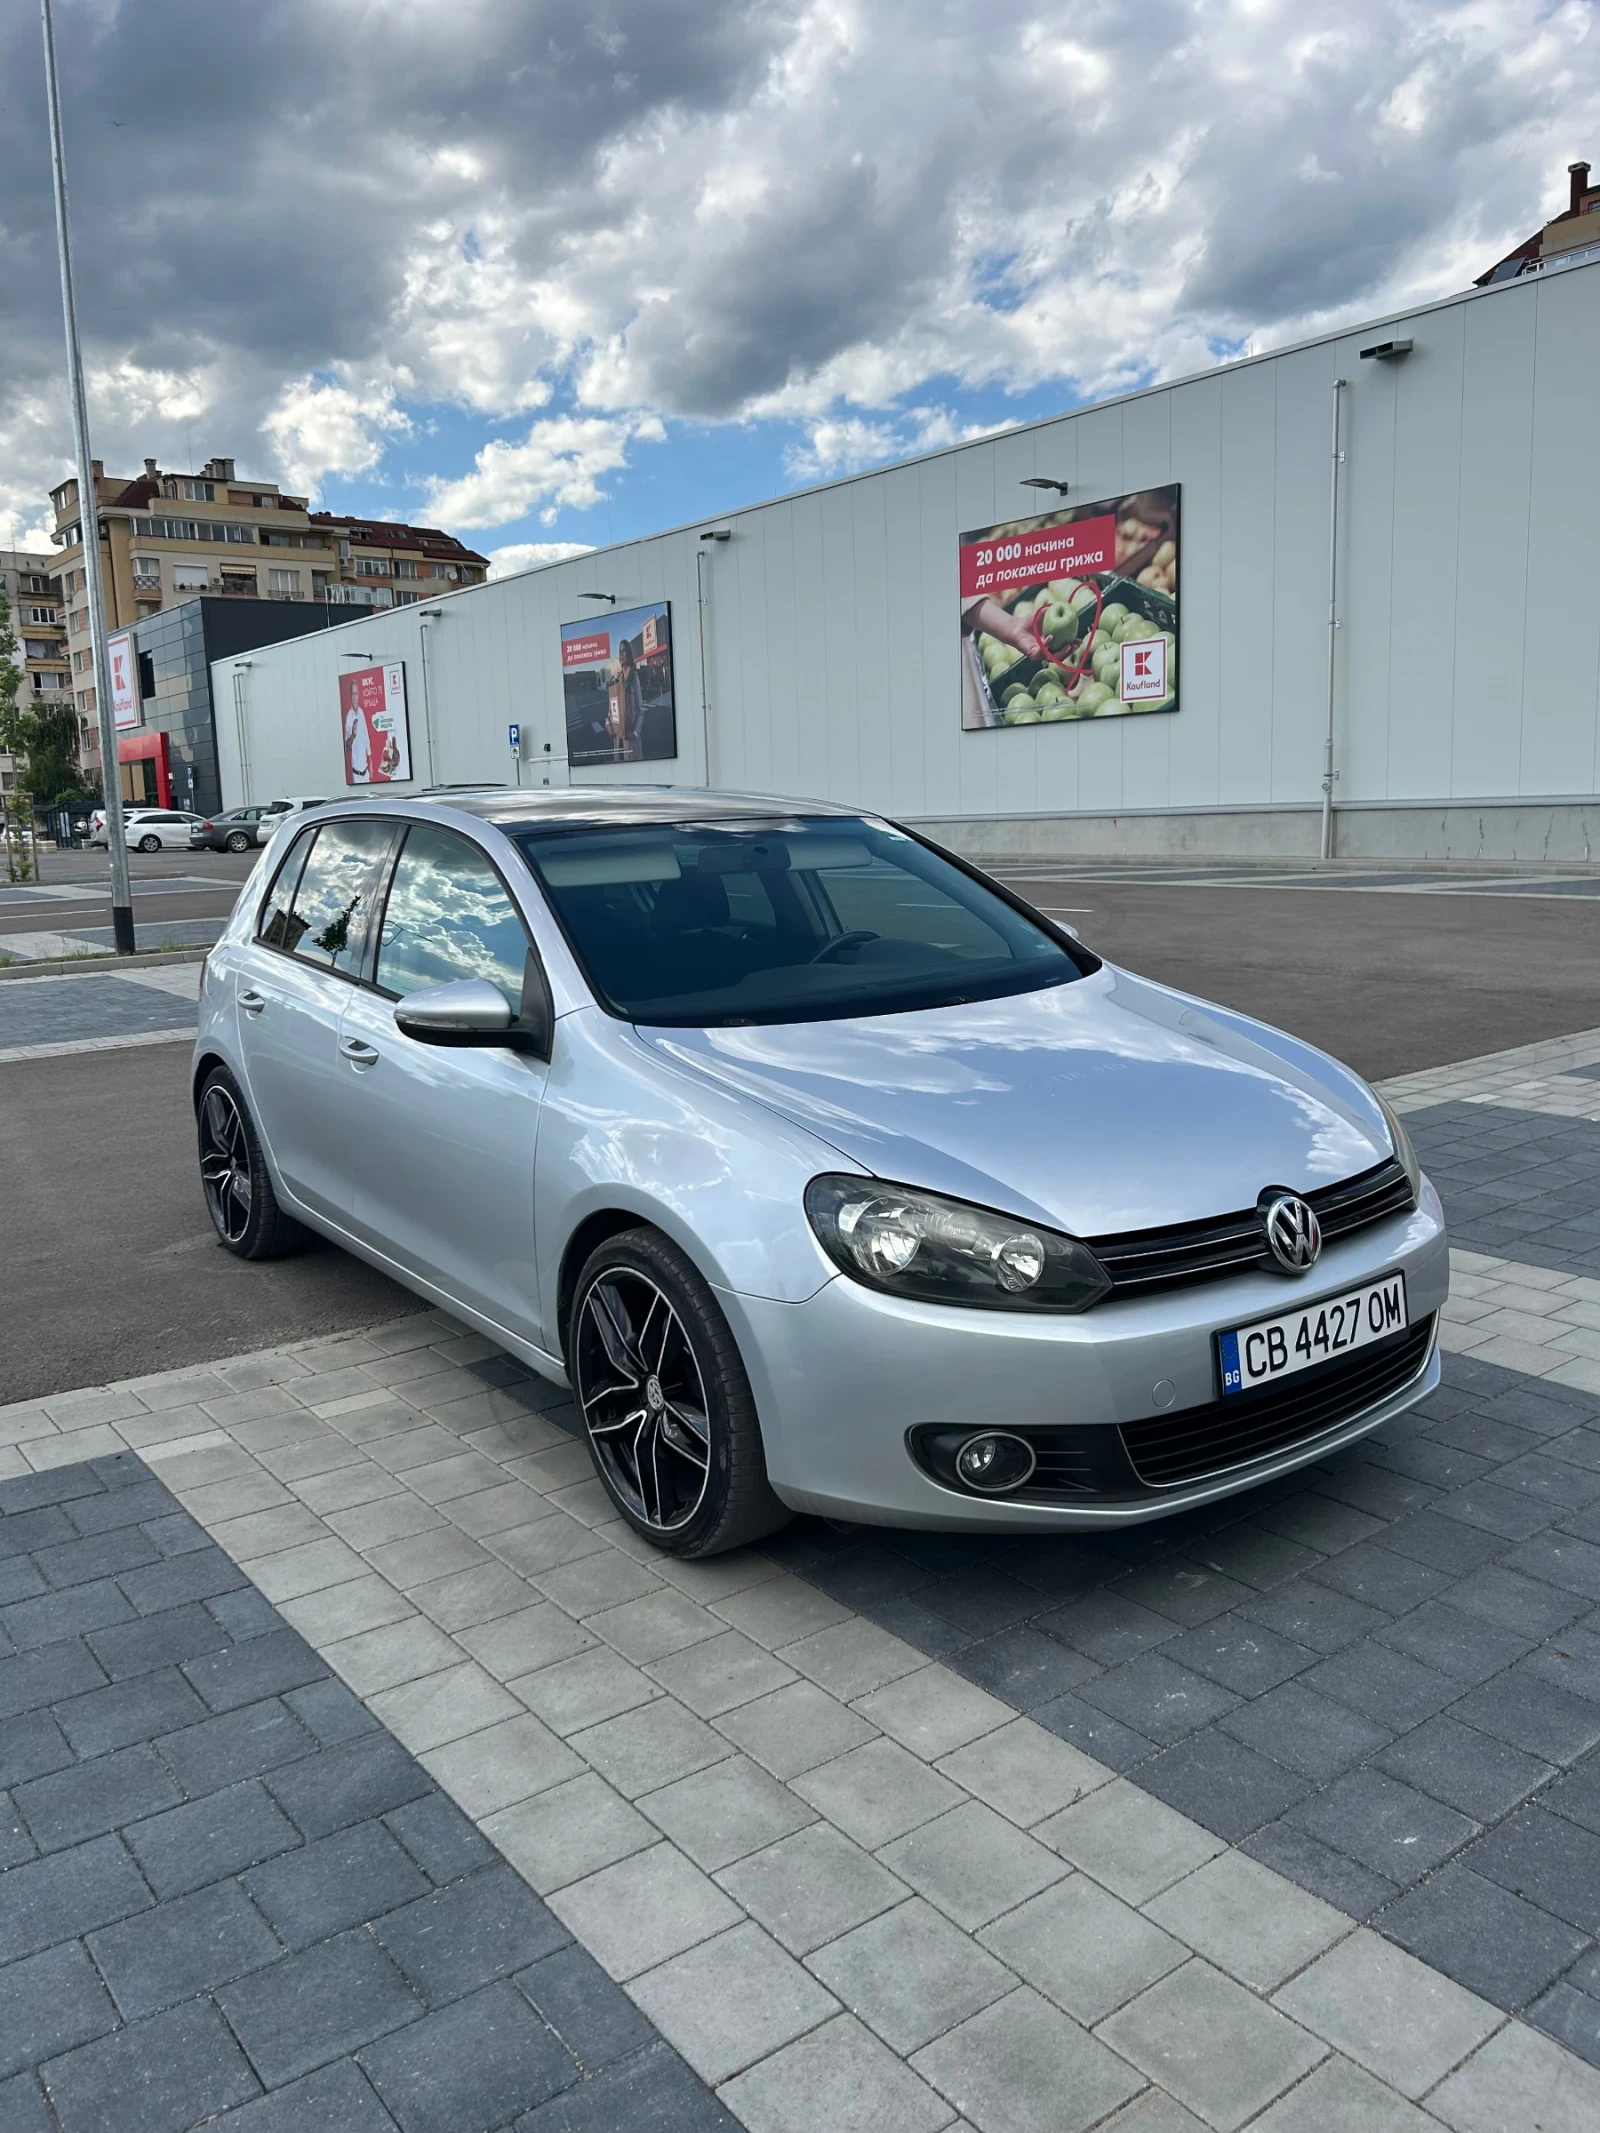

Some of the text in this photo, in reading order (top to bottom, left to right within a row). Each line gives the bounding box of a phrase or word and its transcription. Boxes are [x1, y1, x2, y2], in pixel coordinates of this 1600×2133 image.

[976, 537, 1074, 566] 20 000 начина
[976, 550, 1103, 589] да покажеш грижа
[1134, 651, 1153, 676] K
[1126, 679, 1160, 691] Kaufland
[511, 727, 518, 744] P
[1245, 1282, 1402, 1378] CB 4427 OM
[1225, 1369, 1240, 1387] BG
